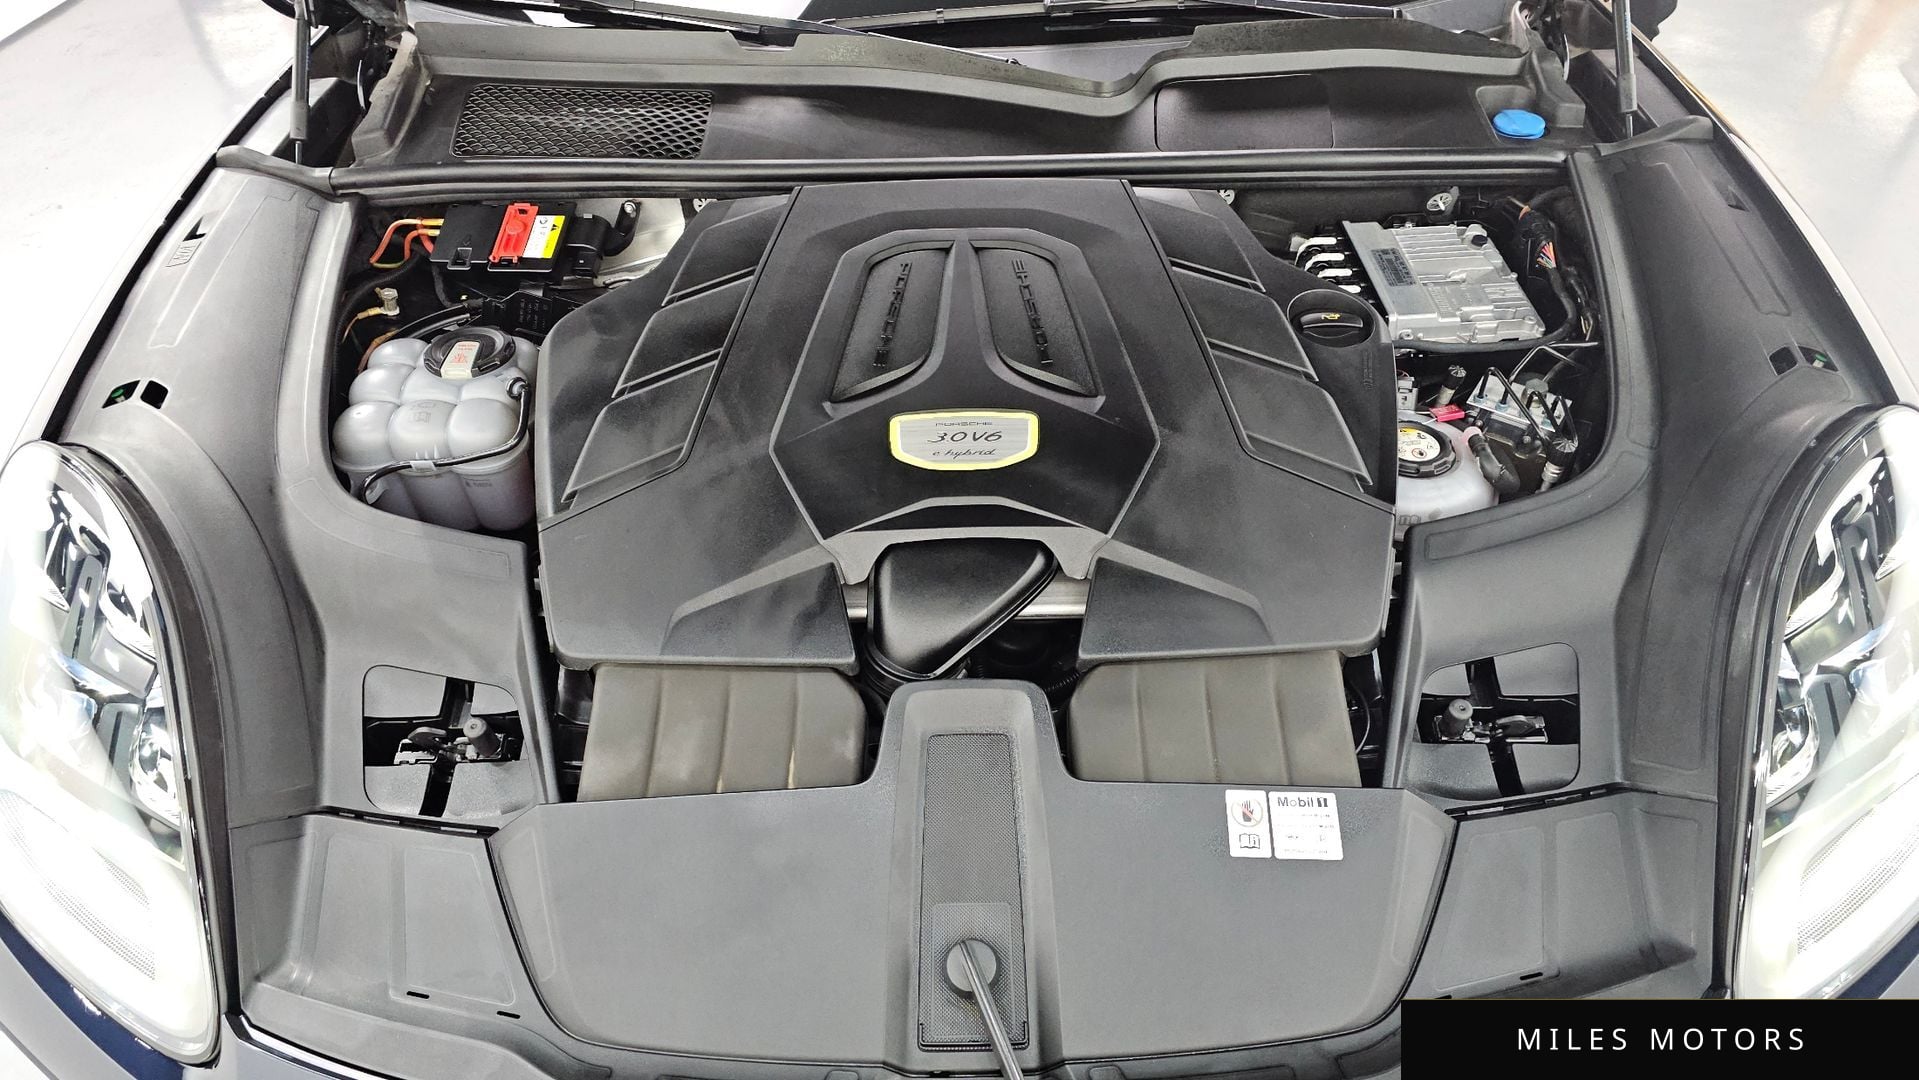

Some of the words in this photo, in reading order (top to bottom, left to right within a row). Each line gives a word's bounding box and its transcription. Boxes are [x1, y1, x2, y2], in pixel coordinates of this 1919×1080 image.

[972, 431, 1002, 442] V6
[944, 449, 995, 459] hybrid
[1277, 796, 1315, 808] Mobil
